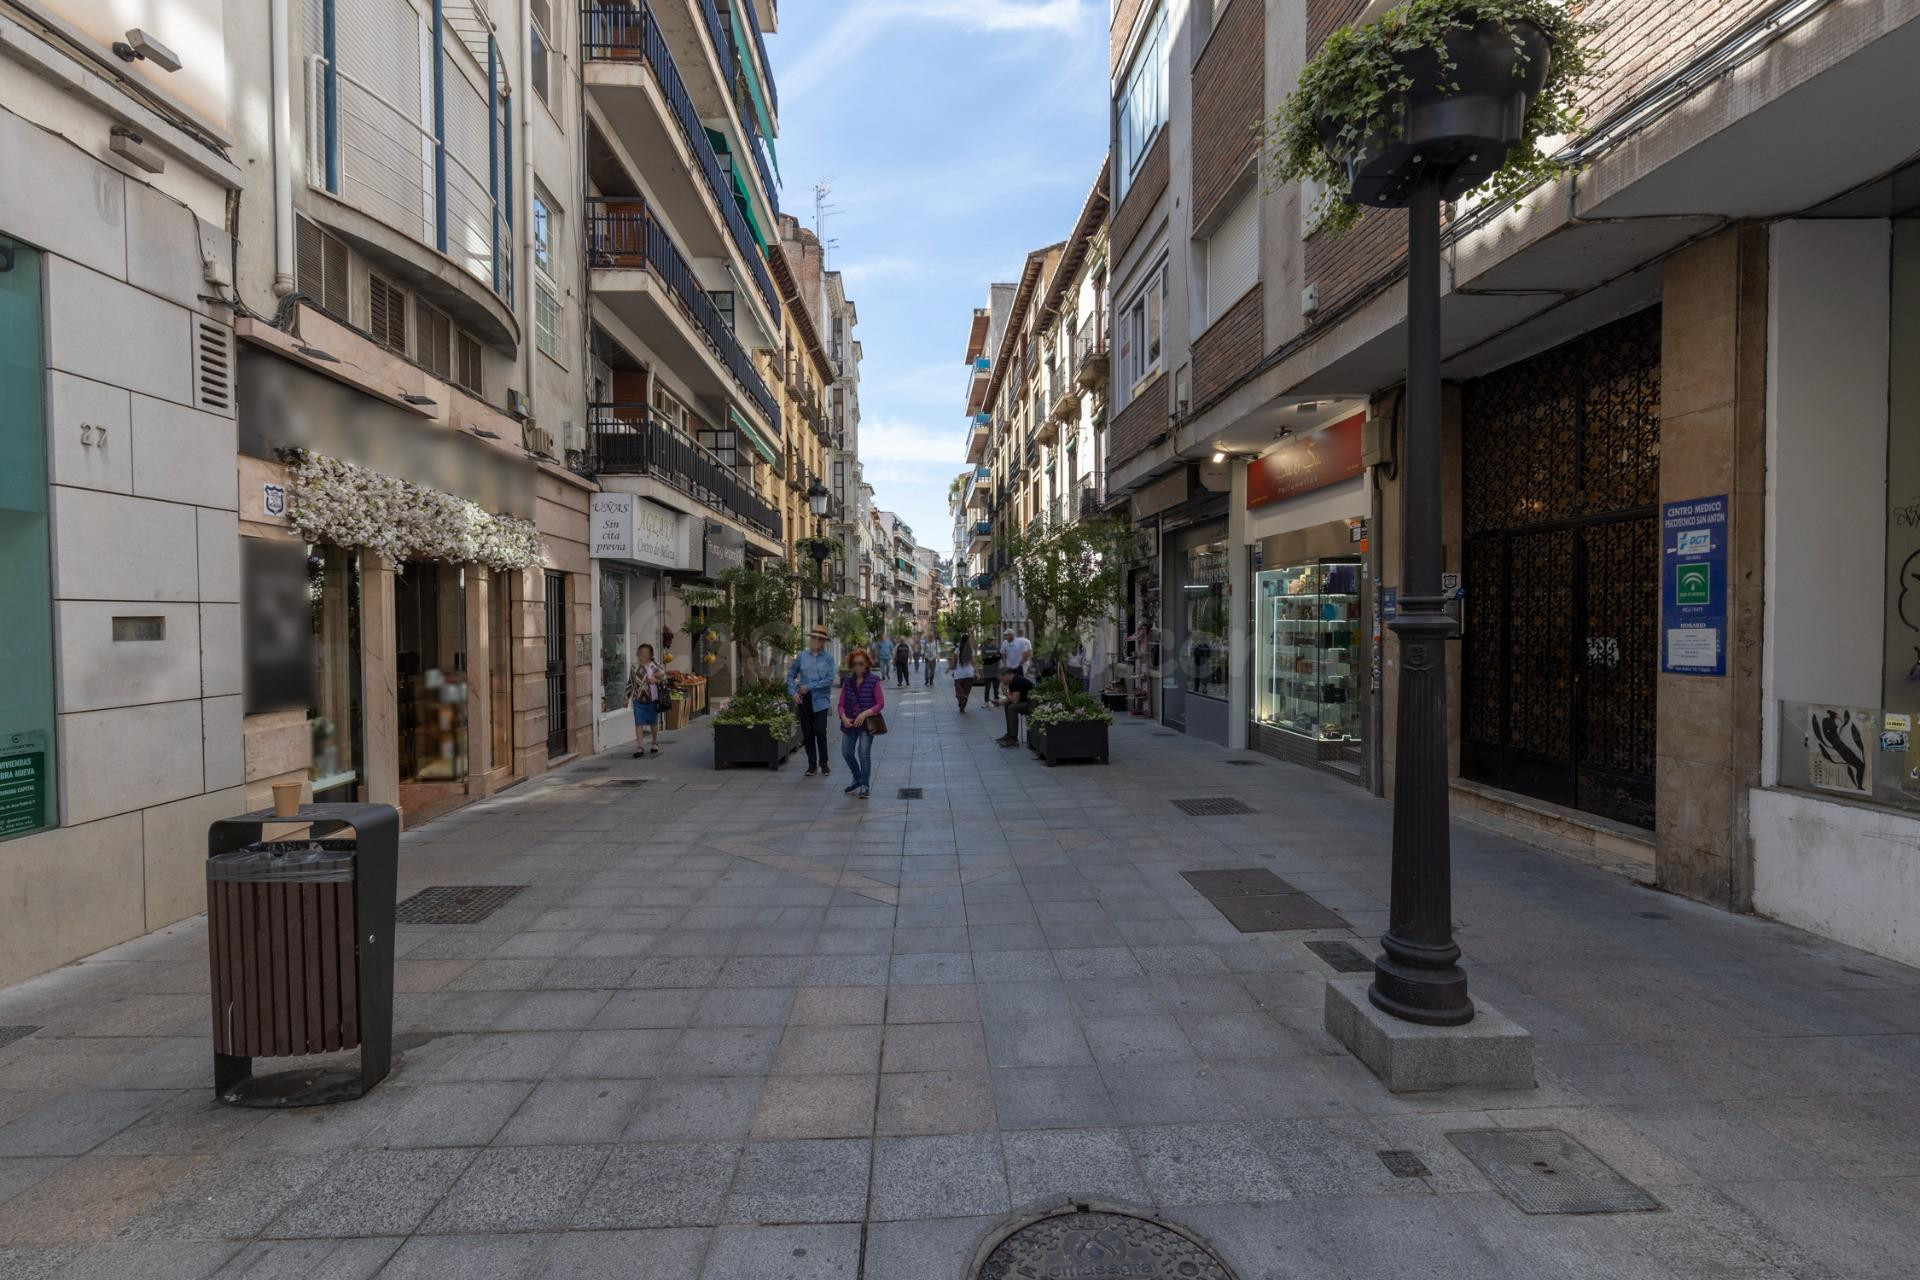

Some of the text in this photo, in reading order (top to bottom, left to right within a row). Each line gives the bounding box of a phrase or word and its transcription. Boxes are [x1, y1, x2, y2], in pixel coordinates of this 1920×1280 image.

[80, 422, 108, 448] 27
[592, 501, 629, 514] UÑAS
[1667, 502, 1721, 518] CENTRO MEDICO
[602, 519, 620, 529] Sin
[1696, 514, 1707, 525] SAN
[602, 530, 621, 541] cita
[1689, 535, 1709, 545] DGT
[596, 542, 626, 554] previa
[15, 767, 35, 778] NUEVA
